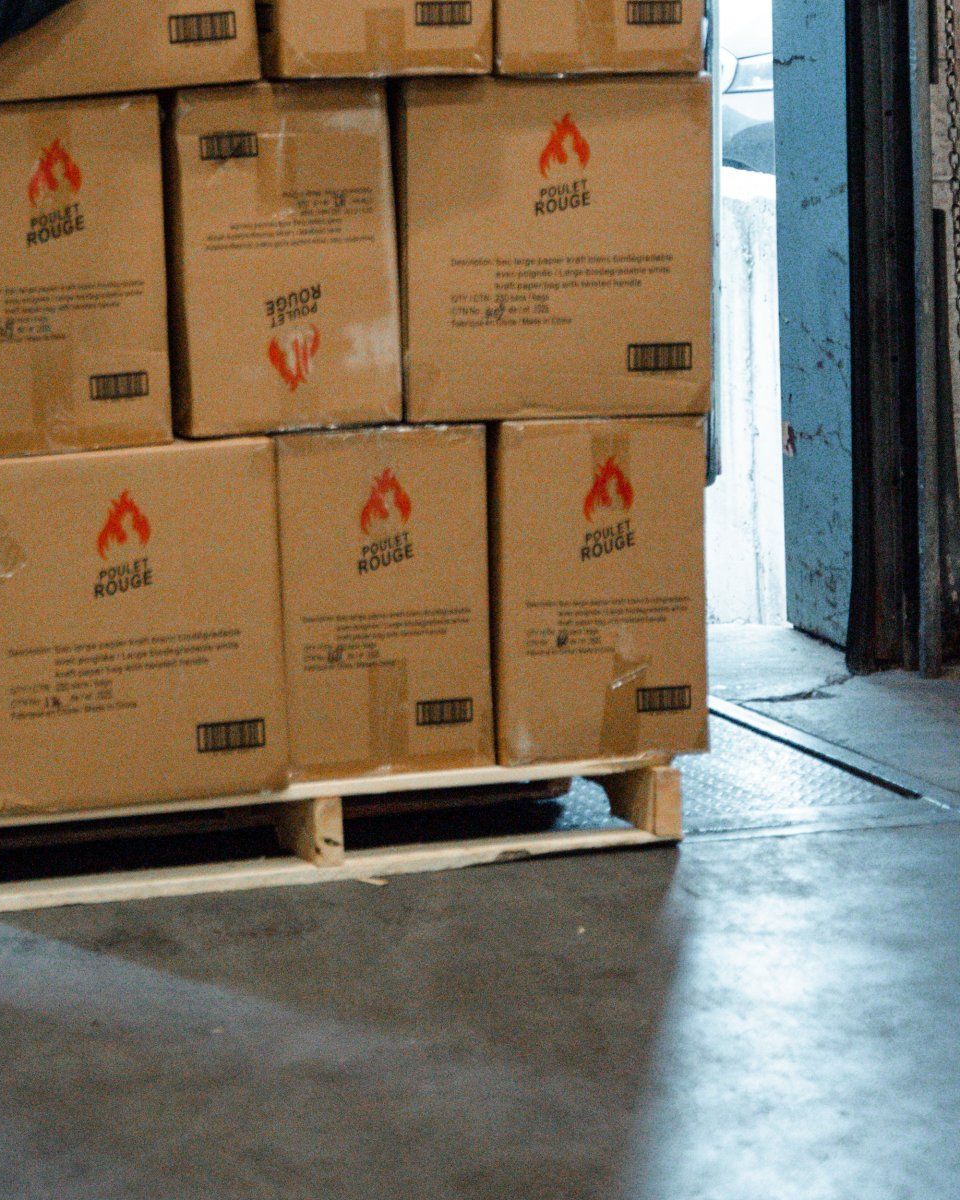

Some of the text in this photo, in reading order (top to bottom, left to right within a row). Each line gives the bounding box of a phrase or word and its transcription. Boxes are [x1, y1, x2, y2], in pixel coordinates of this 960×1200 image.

[539, 180, 587, 199] POULET
[30, 203, 78, 227] POULET
[534, 191, 589, 216] ROUGE
[26, 215, 84, 247] ROUGE
[264, 284, 321, 317] ROUGE
[585, 518, 631, 543] POULET
[362, 531, 410, 557] POULET
[579, 530, 635, 562] ROUGE
[99, 558, 149, 581] POULET
[357, 543, 414, 575] ROUGE
[93, 569, 154, 600] ROUGE
